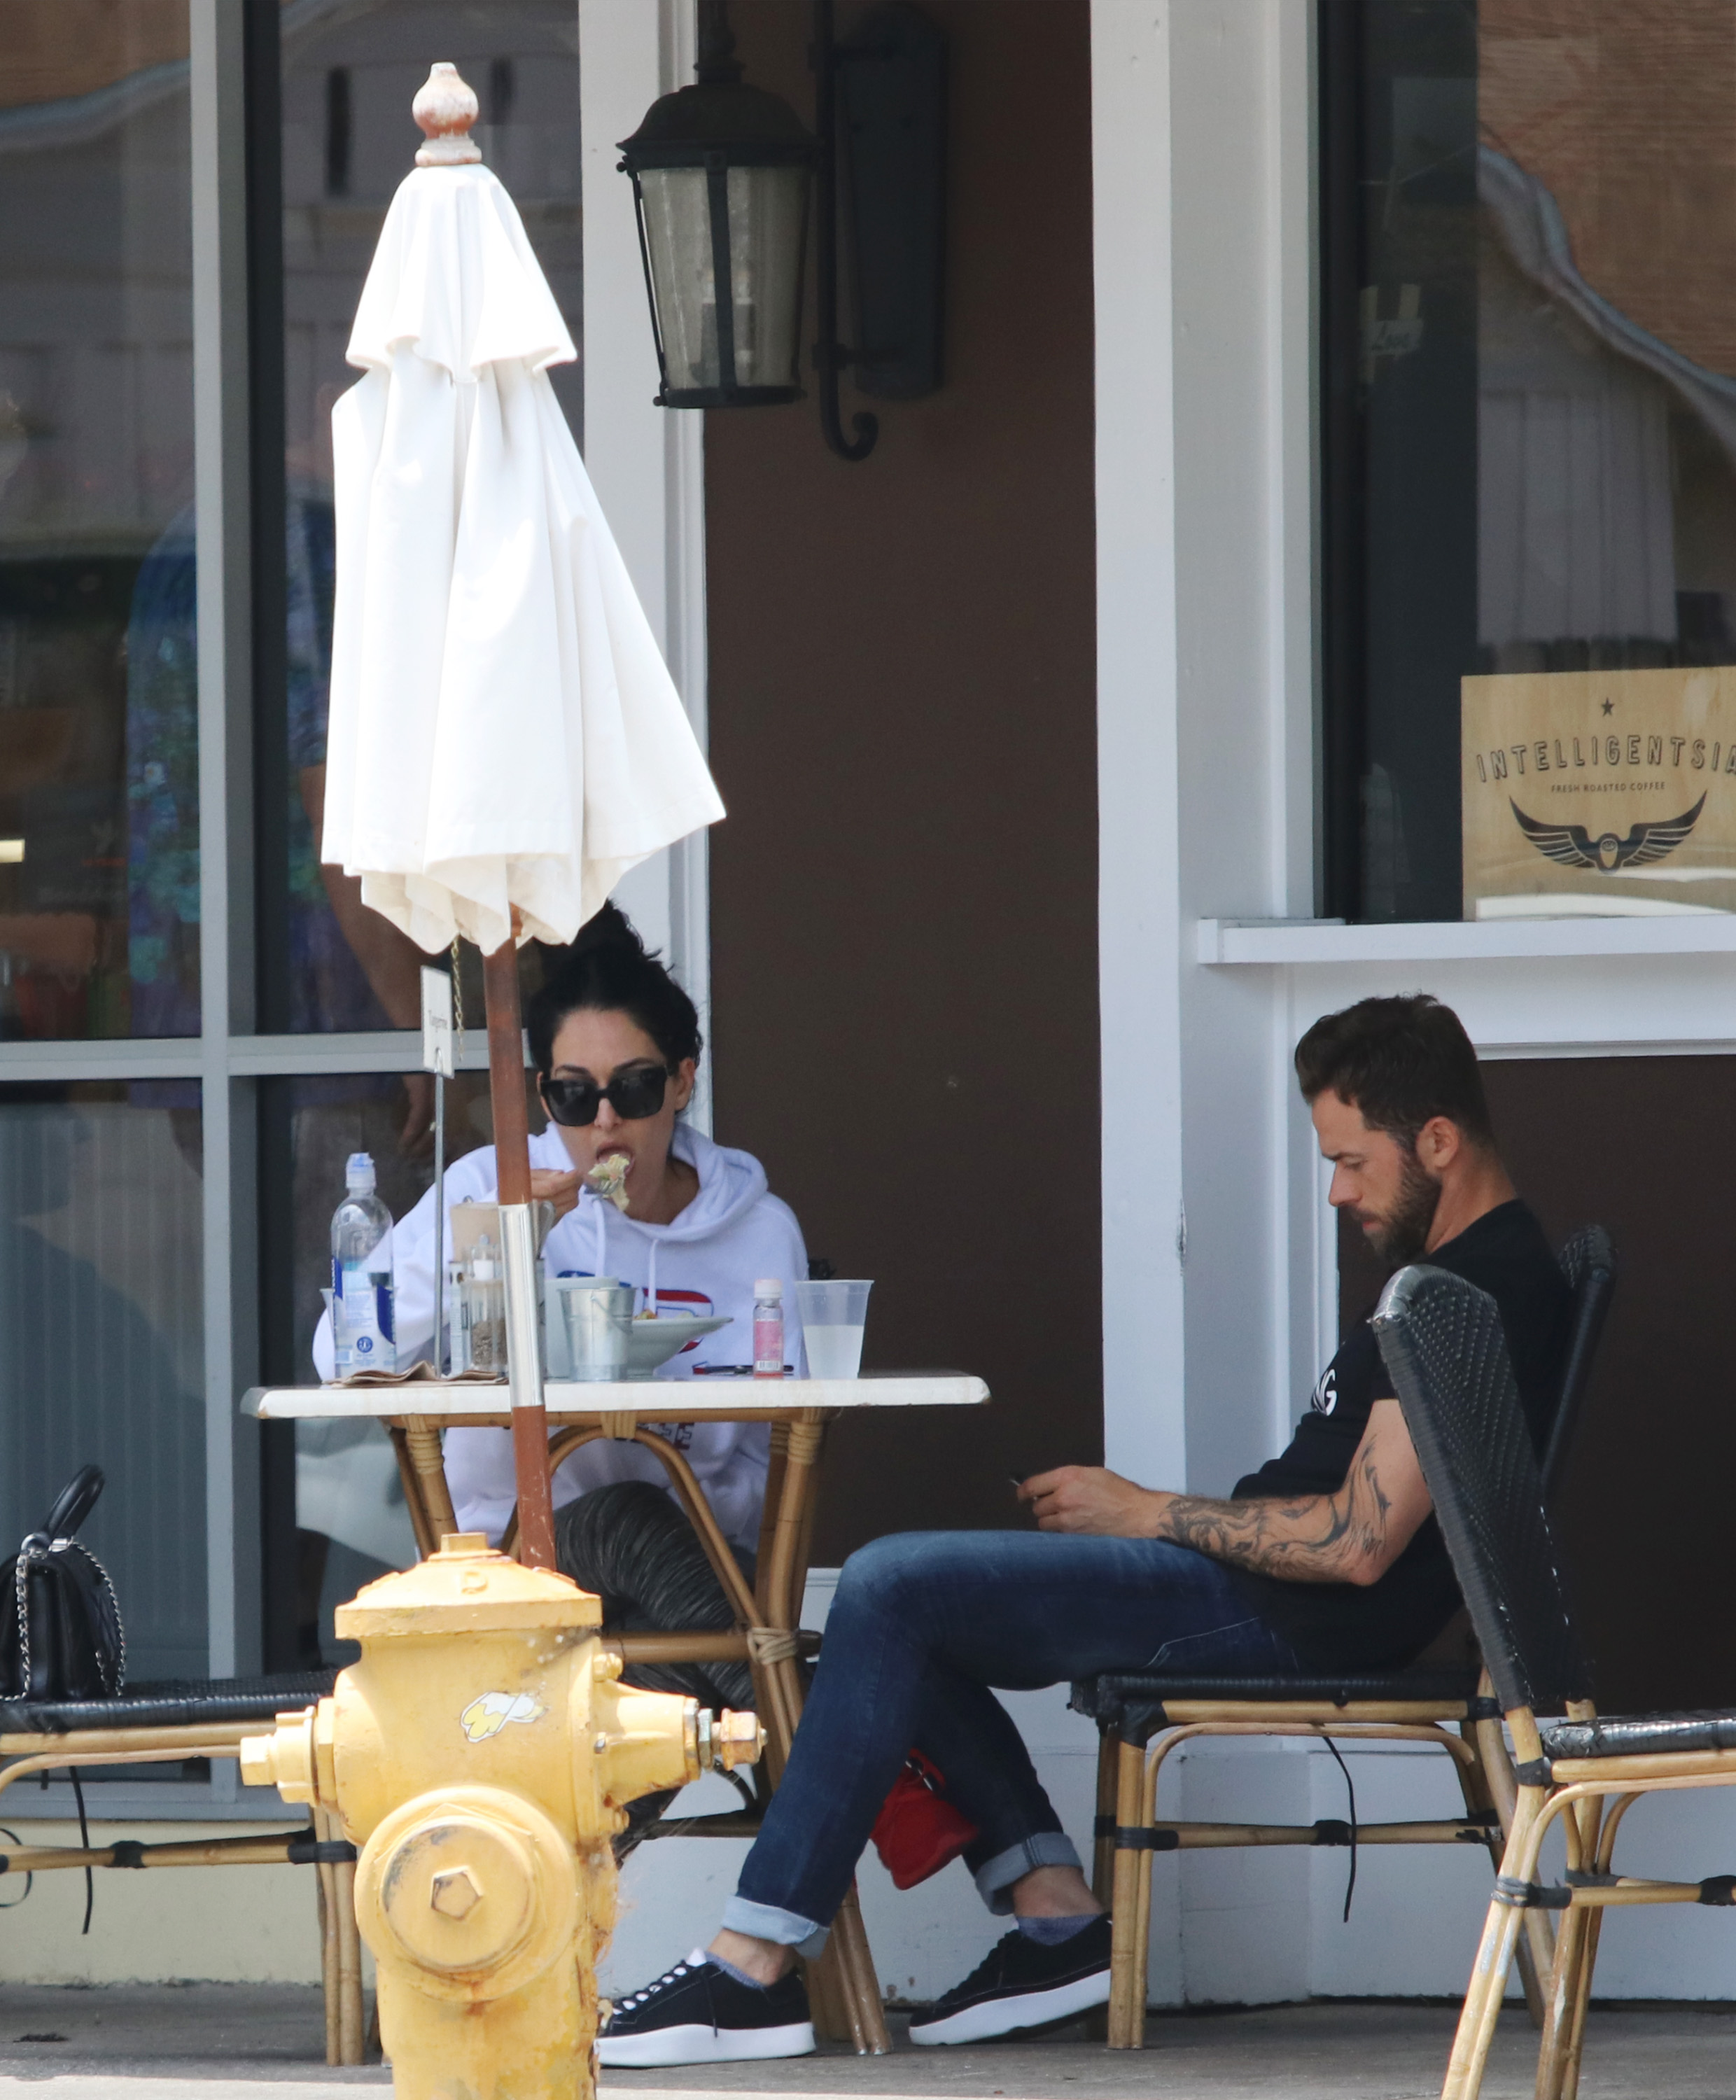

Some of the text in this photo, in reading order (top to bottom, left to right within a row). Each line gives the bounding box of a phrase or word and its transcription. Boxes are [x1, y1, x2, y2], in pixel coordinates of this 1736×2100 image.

[1476, 734, 1736, 783] INTELLIGENTSIA
[1551, 782, 1665, 792] FRESH ROASTED COFFEE
